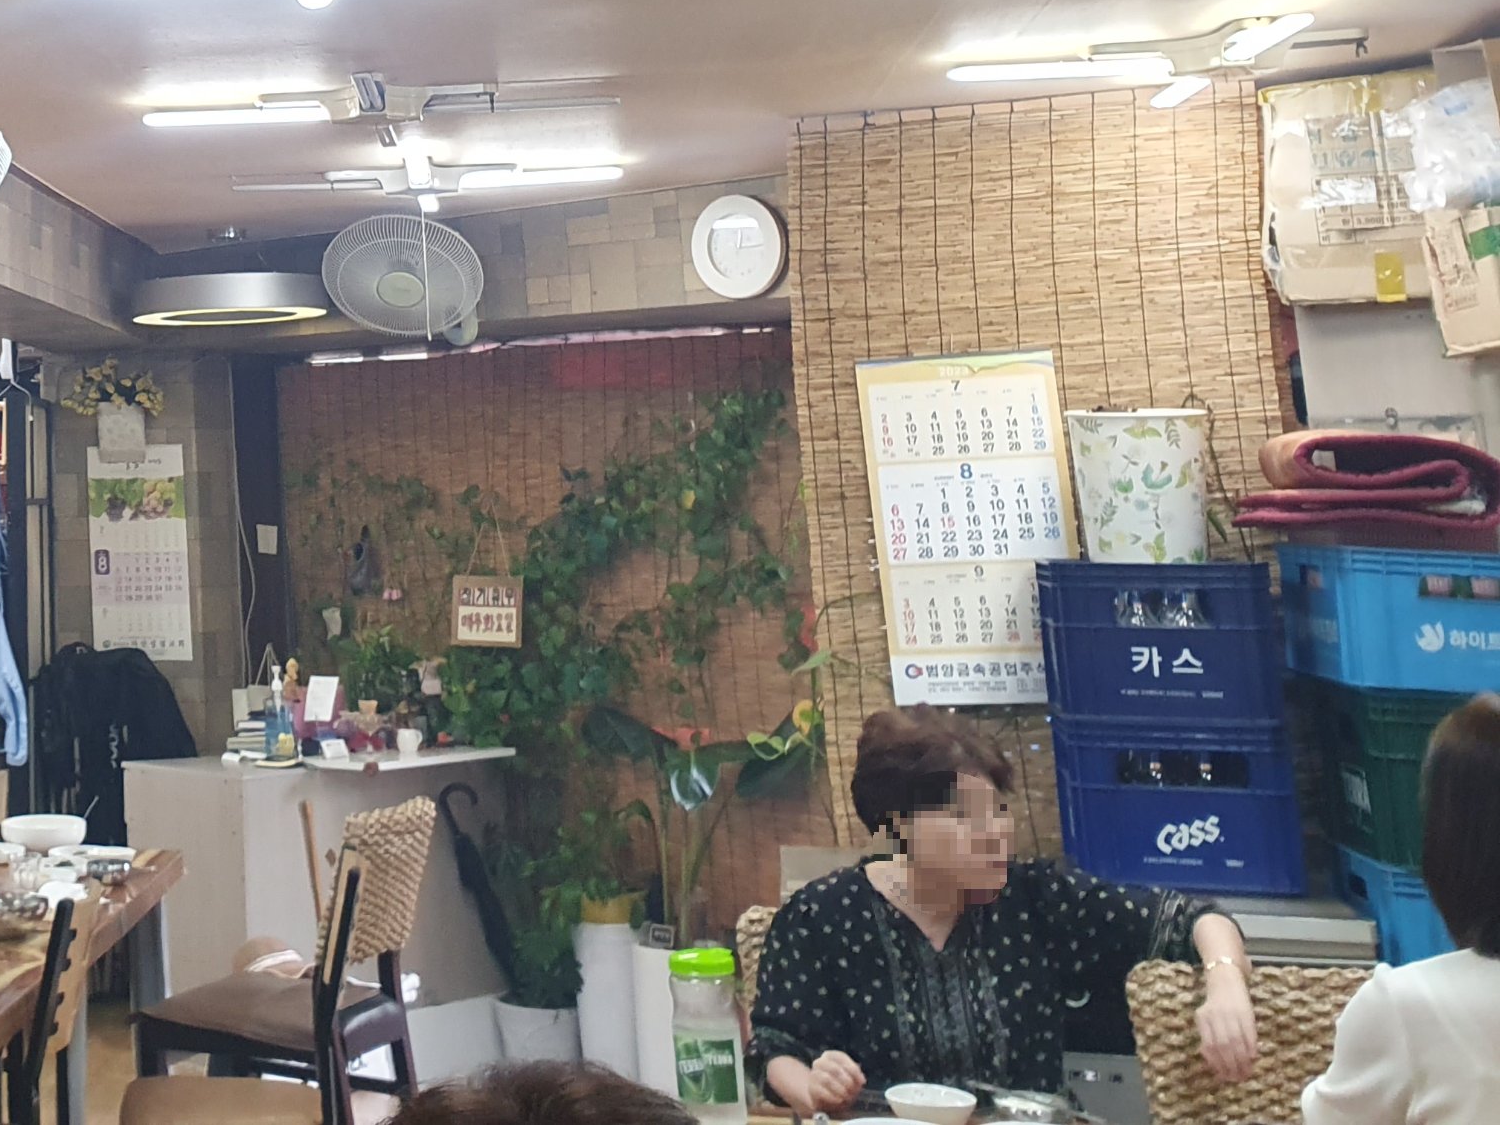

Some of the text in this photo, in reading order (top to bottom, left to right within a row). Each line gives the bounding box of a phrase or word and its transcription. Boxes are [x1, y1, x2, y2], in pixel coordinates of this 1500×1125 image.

[951, 380, 960, 391] 7
[960, 463, 973, 479] 8
[940, 482, 1051, 499] 1 2 3 4 5
[890, 497, 1056, 516] 6 7 8 9 10 11 12
[890, 512, 1058, 531] 13 14 15 16 17 18 19
[890, 527, 1060, 545] 20 21 22 23 24 25 26
[892, 543, 1009, 560] 27 28 29 30 31
[974, 565, 984, 577] 9
[1130, 646, 1204, 678] 카스
